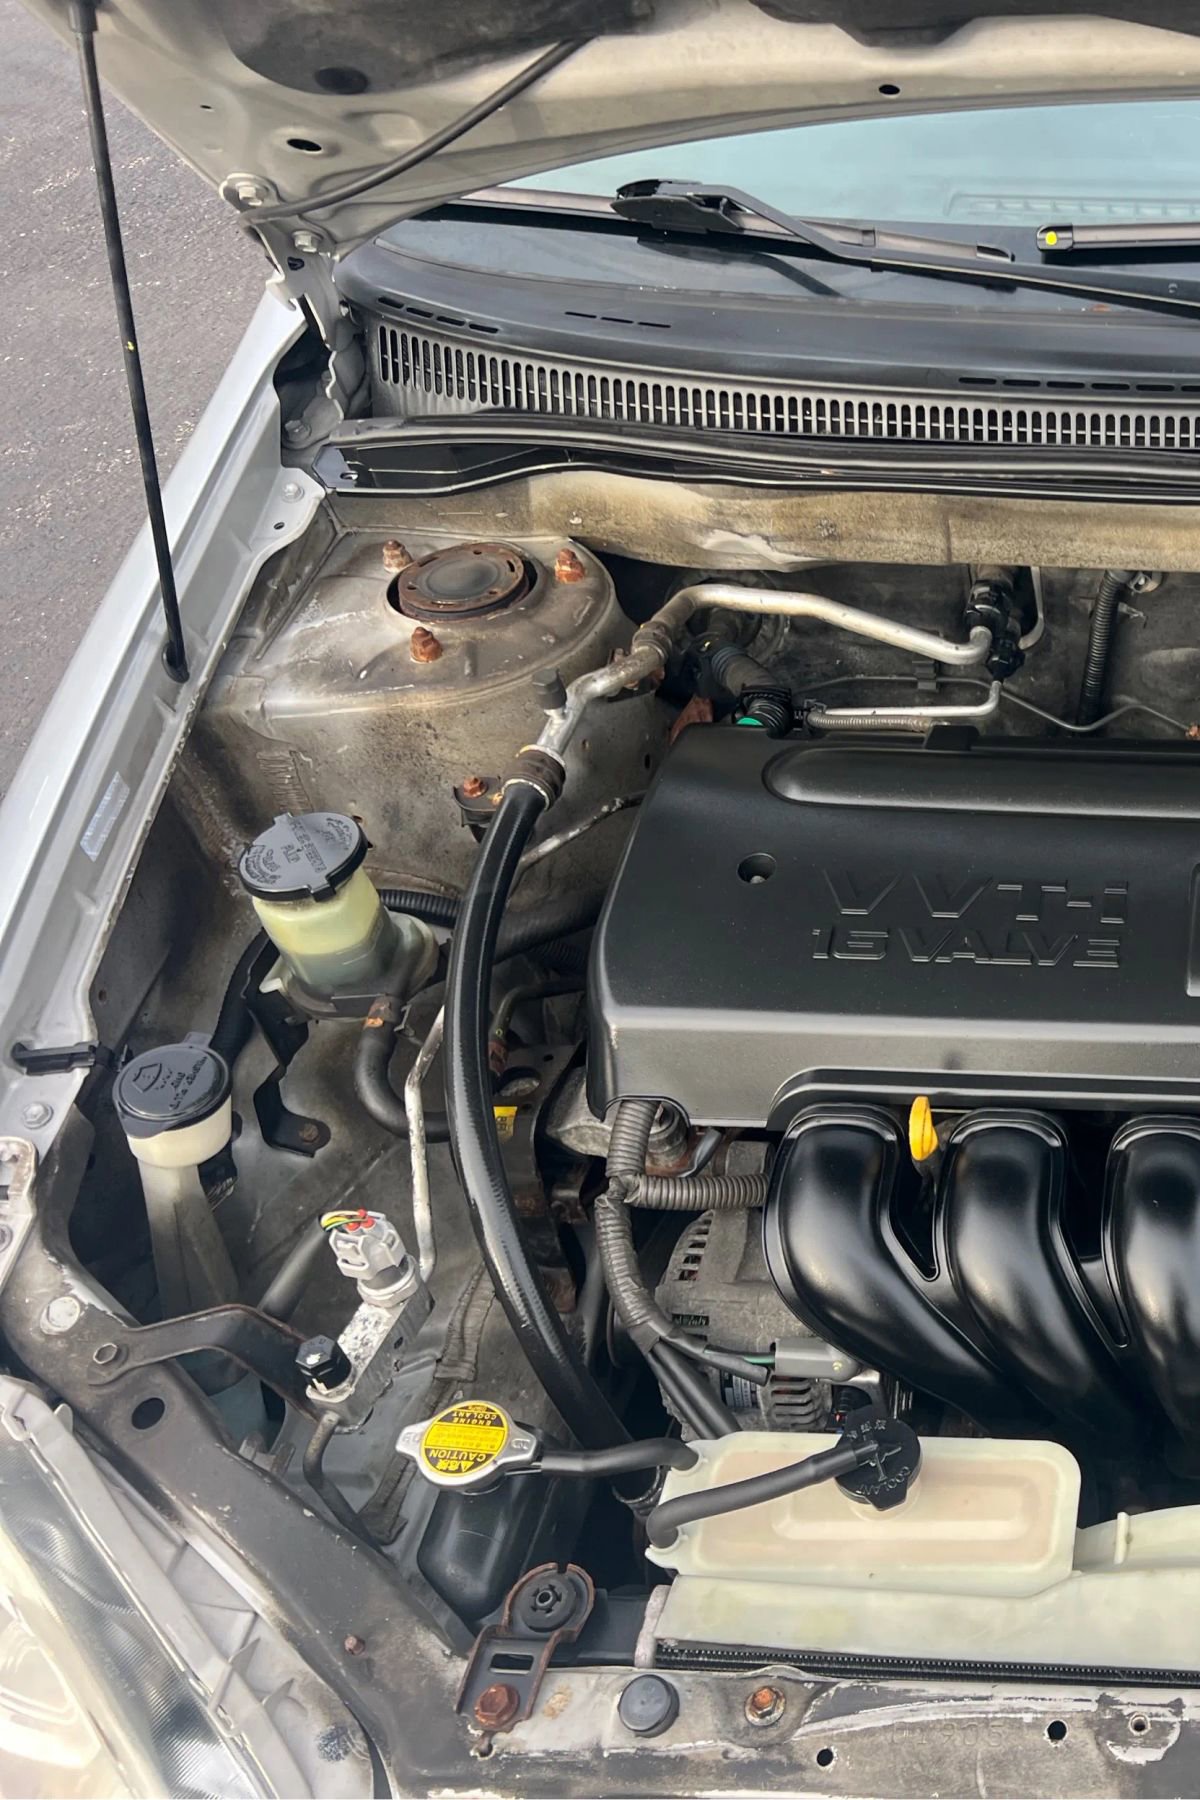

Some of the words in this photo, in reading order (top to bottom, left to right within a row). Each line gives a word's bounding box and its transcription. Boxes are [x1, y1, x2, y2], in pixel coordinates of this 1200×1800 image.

[811, 924, 890, 960] 16
[898, 927, 1122, 969] VALVE
[451, 1410, 498, 1421] COOLANT
[452, 1416, 492, 1427] ENGINE
[429, 1449, 487, 1462] CAUTION
